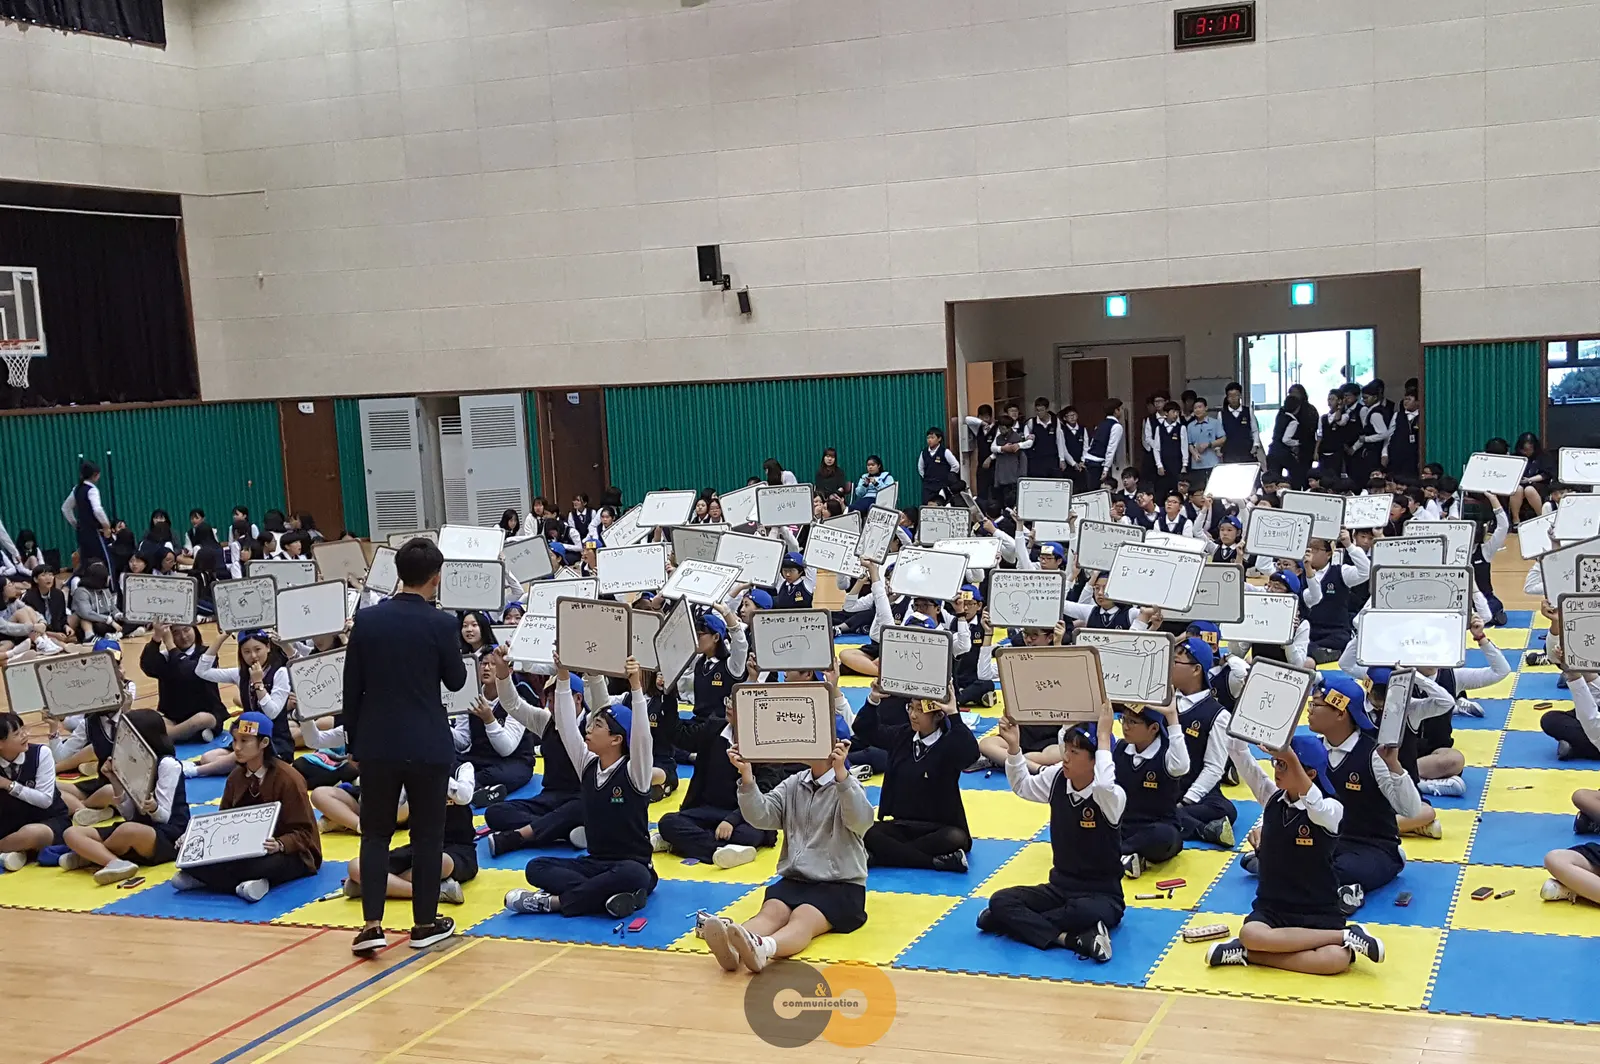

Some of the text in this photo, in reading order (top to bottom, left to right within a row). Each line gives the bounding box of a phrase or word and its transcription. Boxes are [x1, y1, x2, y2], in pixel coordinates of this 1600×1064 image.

[1196, 13, 1240, 35] 3:17
[1331, 697, 1342, 706] 82
[775, 711, 806, 725] 금단현상
[243, 725, 253, 734] 31
